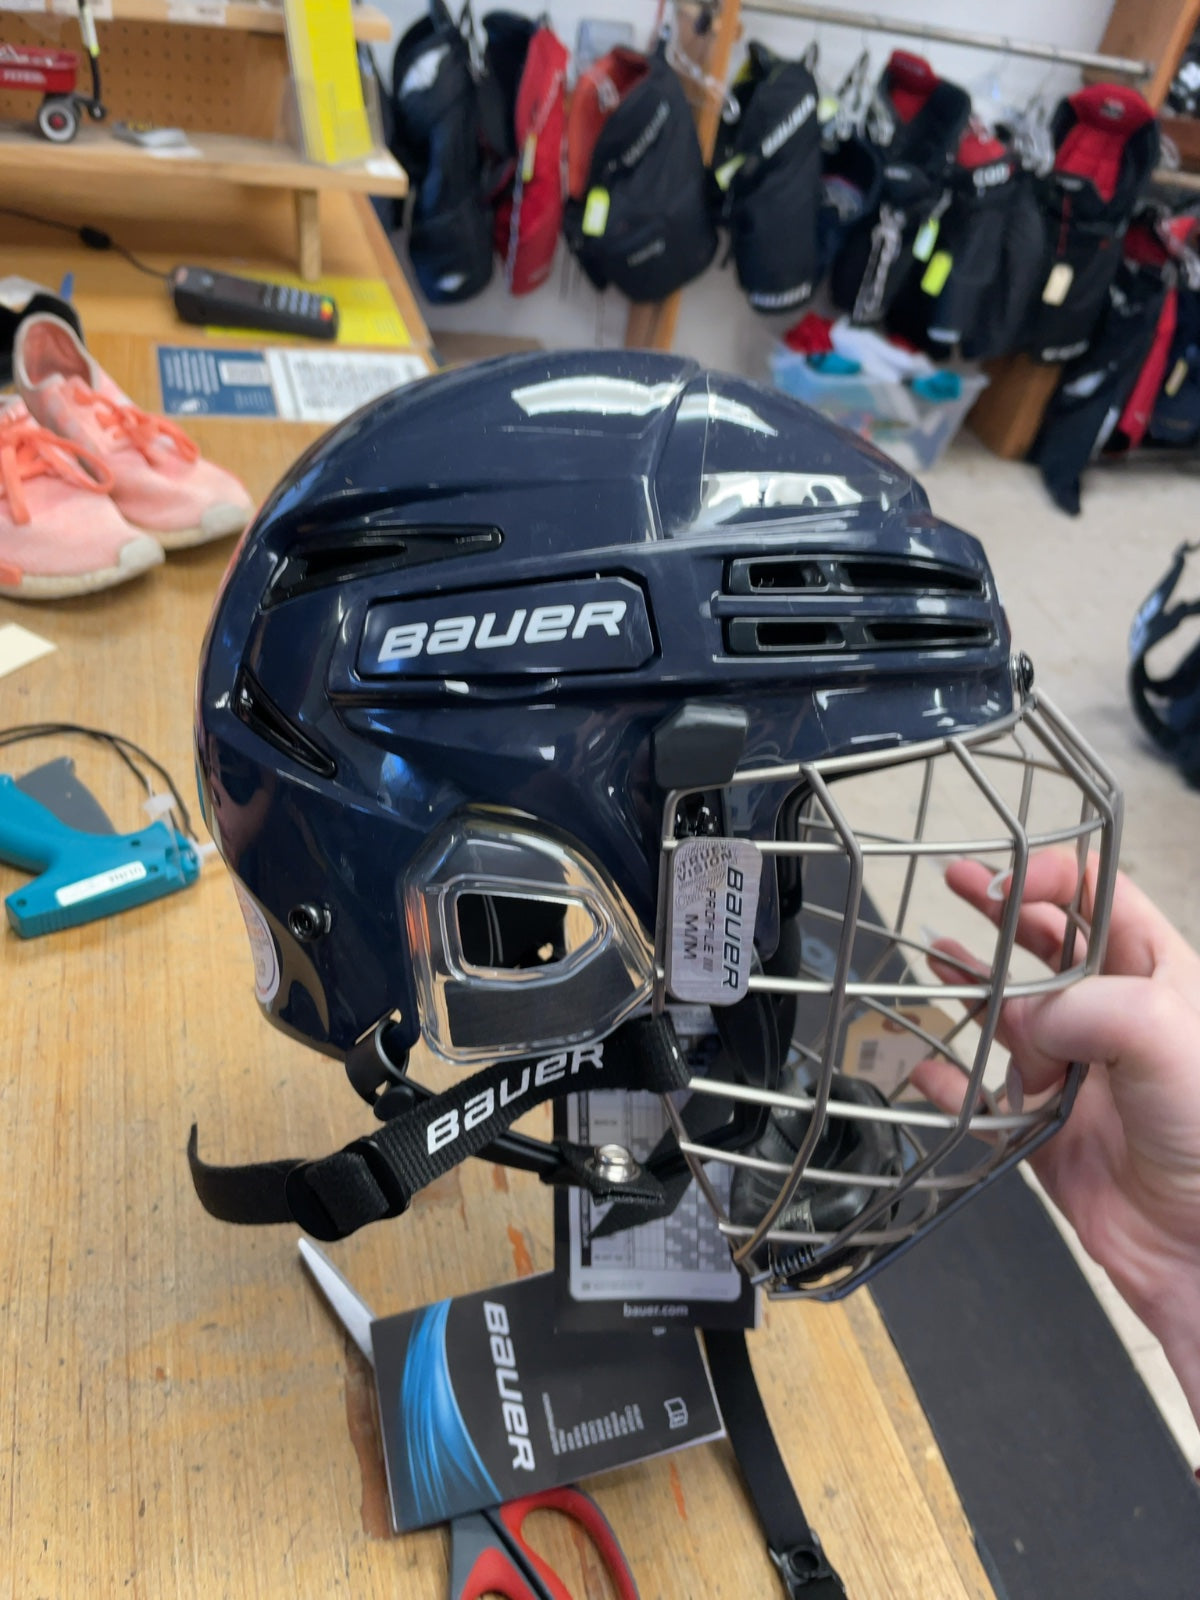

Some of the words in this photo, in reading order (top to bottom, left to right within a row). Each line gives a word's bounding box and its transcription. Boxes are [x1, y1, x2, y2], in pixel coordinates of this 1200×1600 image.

[377, 600, 627, 663] BAUER
[684, 913, 699, 960] M/M
[703, 887, 717, 955] PROFILE
[723, 866, 744, 990] BAUER
[426, 1042, 604, 1156] BAUER
[623, 1302, 689, 1318] bauer.com
[484, 1301, 535, 1472] BAUER
